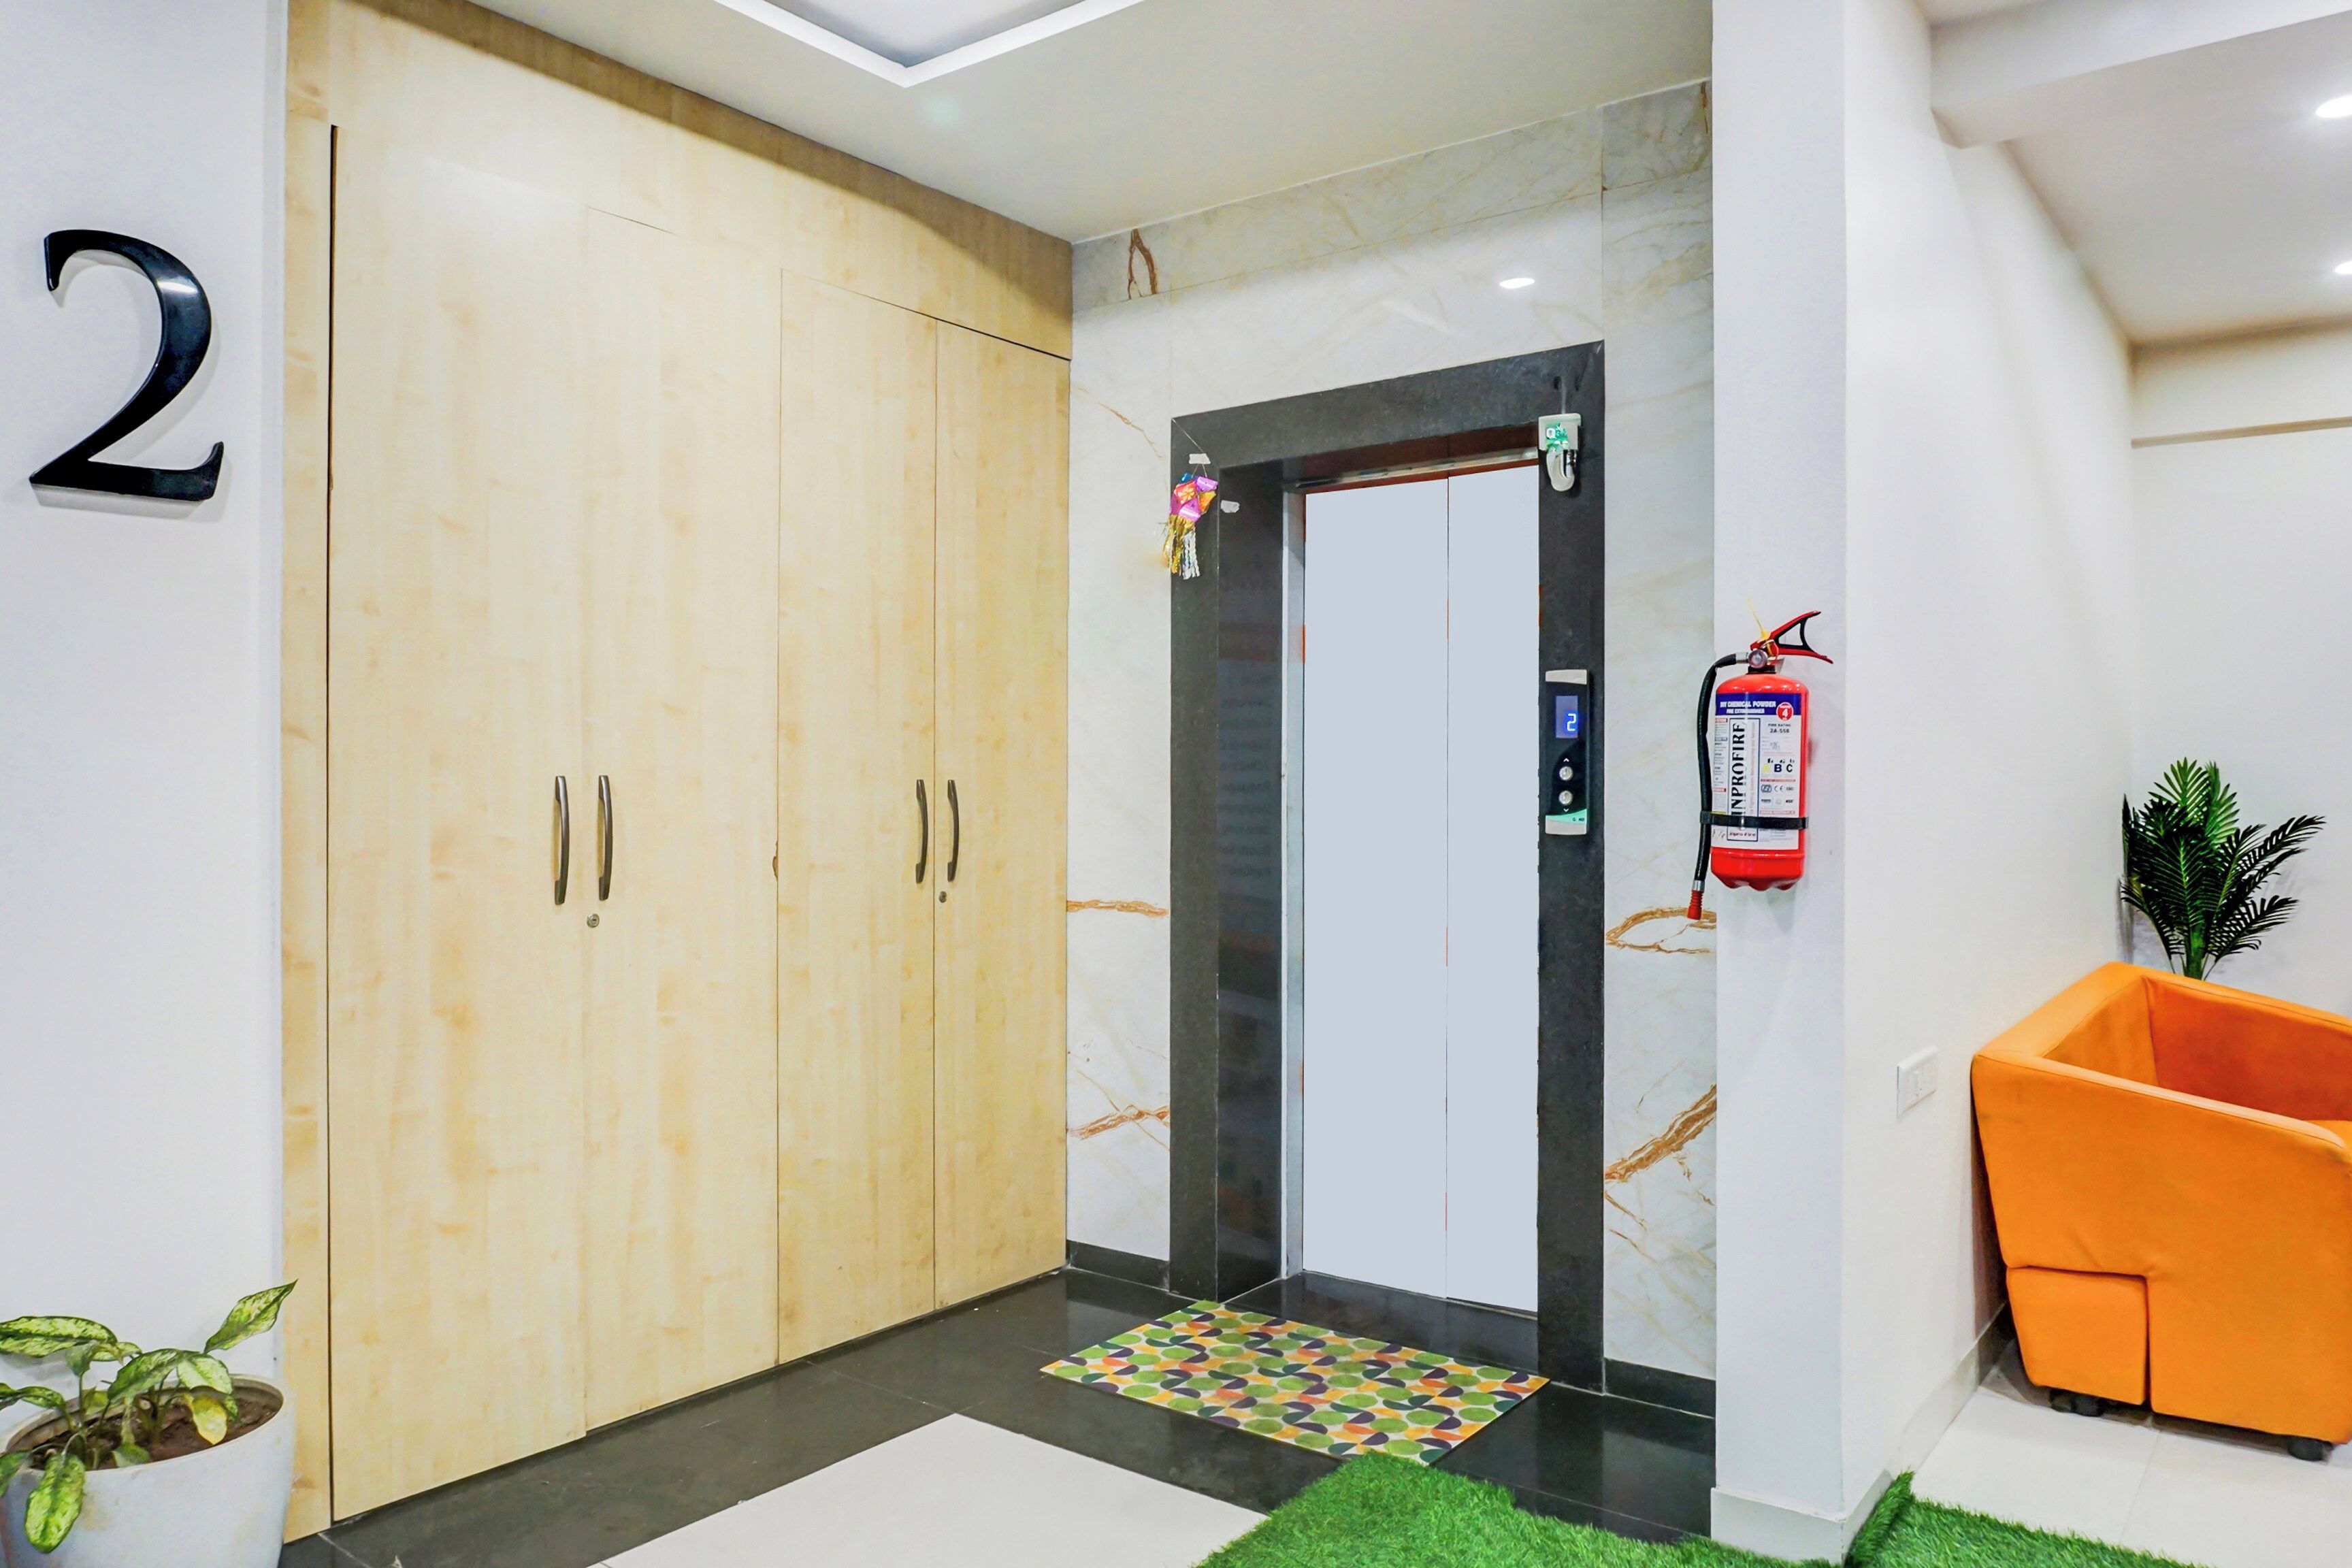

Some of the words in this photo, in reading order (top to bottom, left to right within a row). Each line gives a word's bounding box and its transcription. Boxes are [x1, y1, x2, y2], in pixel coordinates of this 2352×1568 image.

[29, 229, 225, 501] 2
[1782, 708, 1788, 717] 4
[1567, 713, 1577, 732] 2
[1774, 764, 1782, 772] B
[1786, 764, 1793, 772] C
